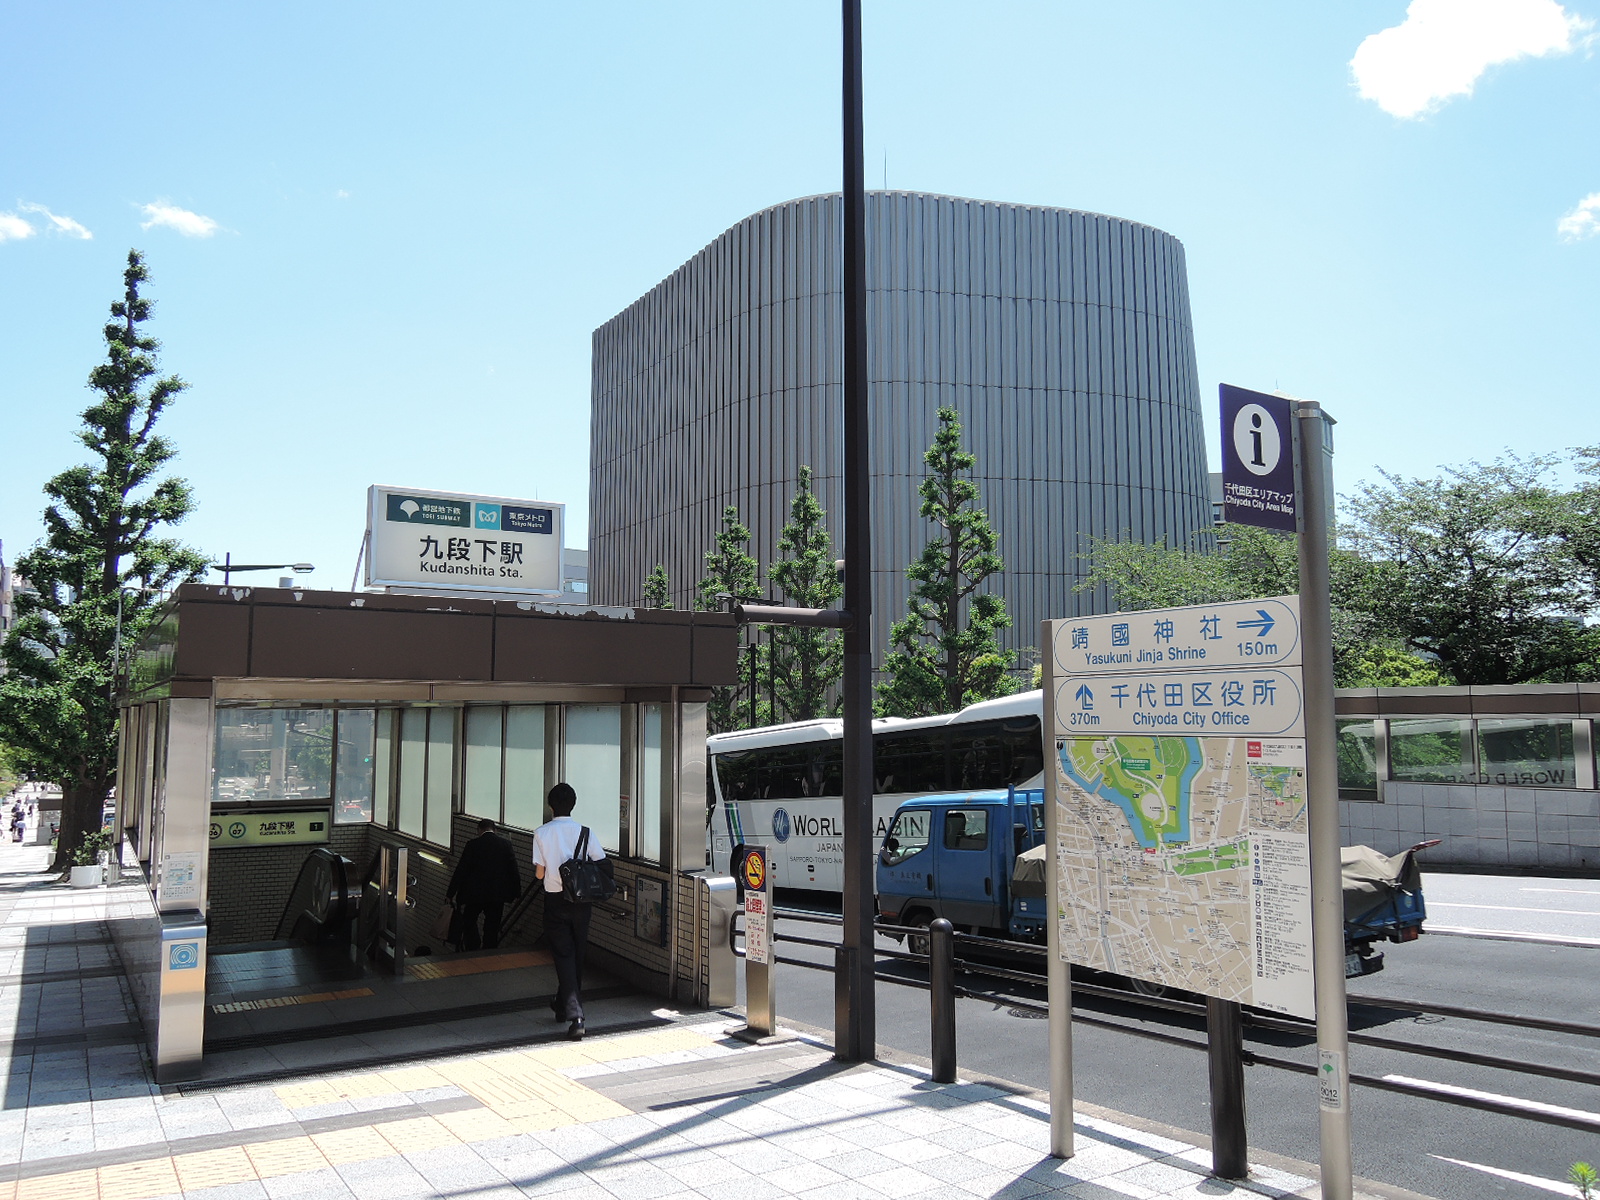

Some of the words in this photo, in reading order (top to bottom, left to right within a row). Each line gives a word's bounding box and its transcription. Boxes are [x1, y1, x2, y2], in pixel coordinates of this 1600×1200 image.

[1225, 483, 1293, 503] 千代田区エリアマップ
[1225, 494, 1251, 507] Chiyoda
[1252, 499, 1264, 511] City
[1265, 501, 1280, 512] Area
[1281, 503, 1294, 515] Map
[436, 514, 461, 522] SUBWAY
[509, 512, 545, 522] 東京メトロ
[511, 520, 527, 528] Tokyo
[419, 535, 523, 565] 九段下駅
[420, 561, 495, 577] Kudanshita
[499, 567, 523, 579] Sta.
[1072, 614, 1223, 650] 靖國神社
[1085, 650, 1132, 665] Yasukuni
[1136, 648, 1163, 664] Jinja
[1168, 647, 1206, 661] Shrine
[1237, 642, 1278, 656] 150m
[1110, 679, 1277, 709] 千代田区役所
[1070, 713, 1100, 725] 370m
[1133, 712, 1178, 728] Chiyoda
[1183, 712, 1206, 728] City
[1211, 711, 1250, 725] Office
[260, 821, 294, 831] 九段下駅
[793, 815, 843, 836] WORL
